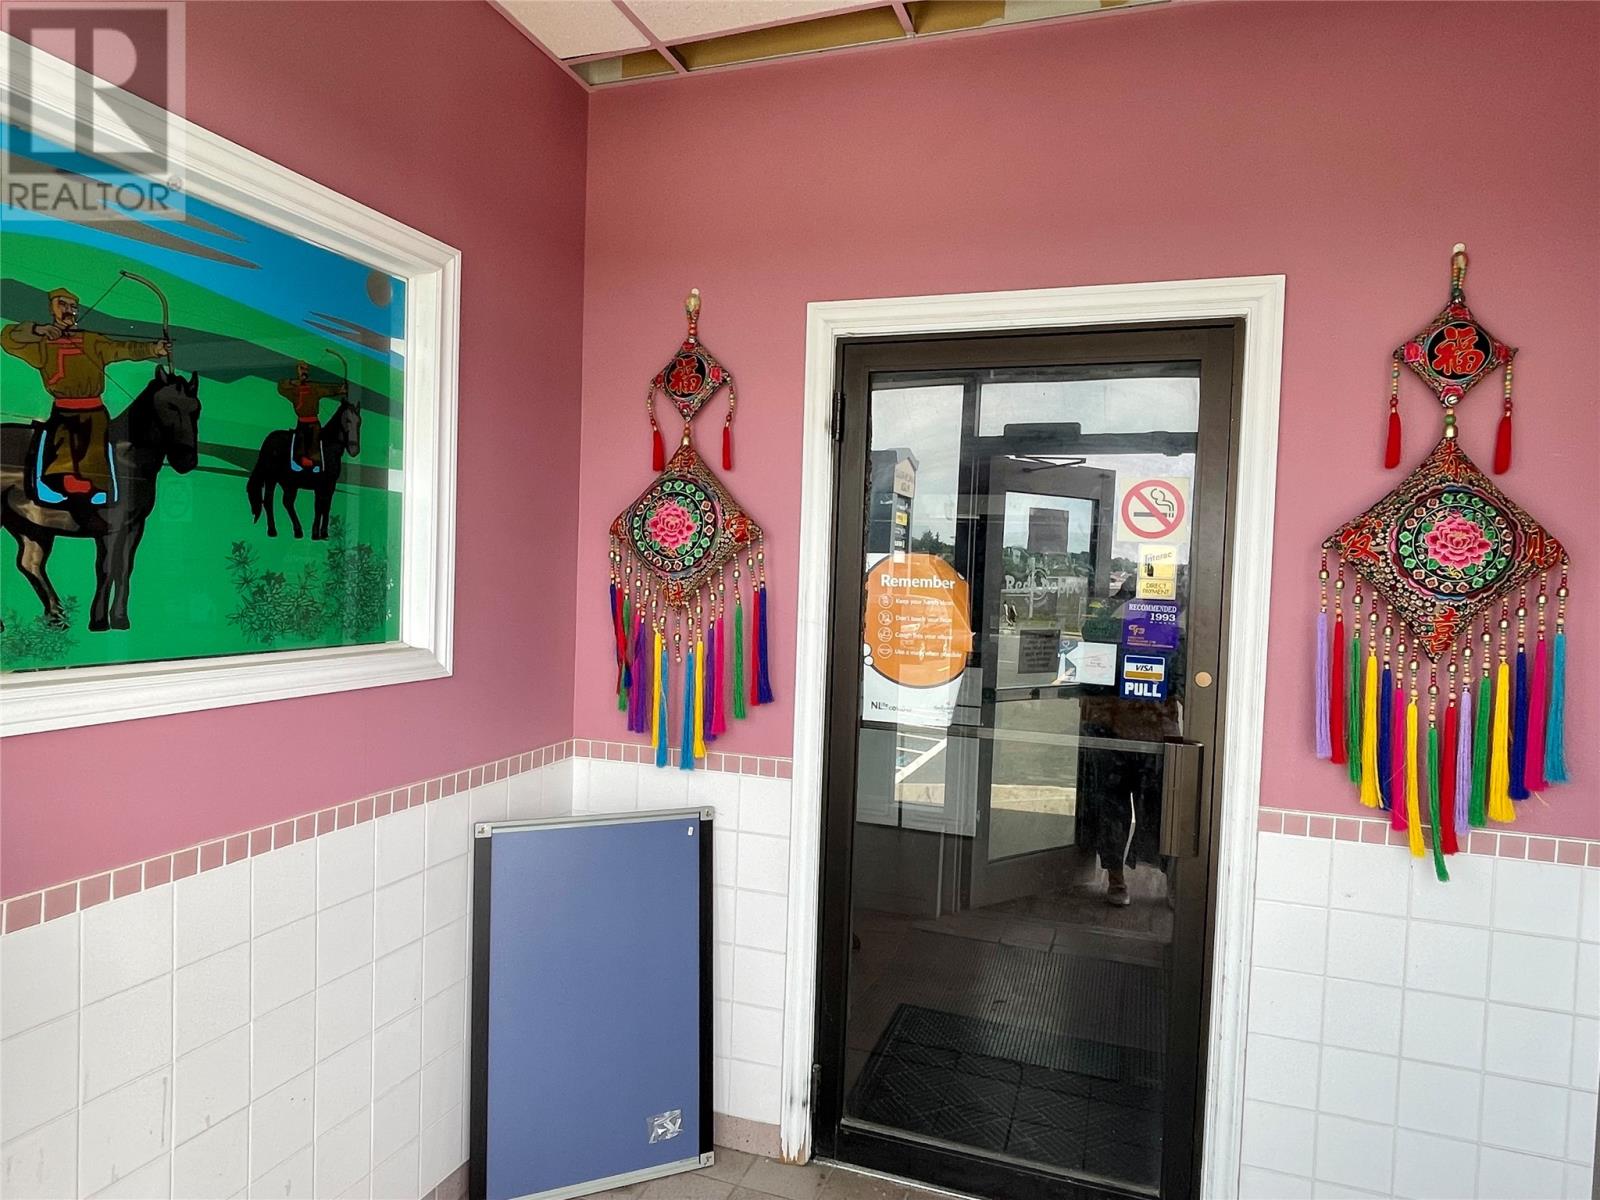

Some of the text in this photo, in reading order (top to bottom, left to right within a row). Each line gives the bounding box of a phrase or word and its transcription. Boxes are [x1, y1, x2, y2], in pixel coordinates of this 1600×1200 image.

[880, 574, 955, 589] Remember
[1128, 603, 1177, 613] RECOMMENDED
[1150, 612, 1176, 622] 1993
[1135, 664, 1154, 672] VISA
[1124, 682, 1162, 698] PULL
